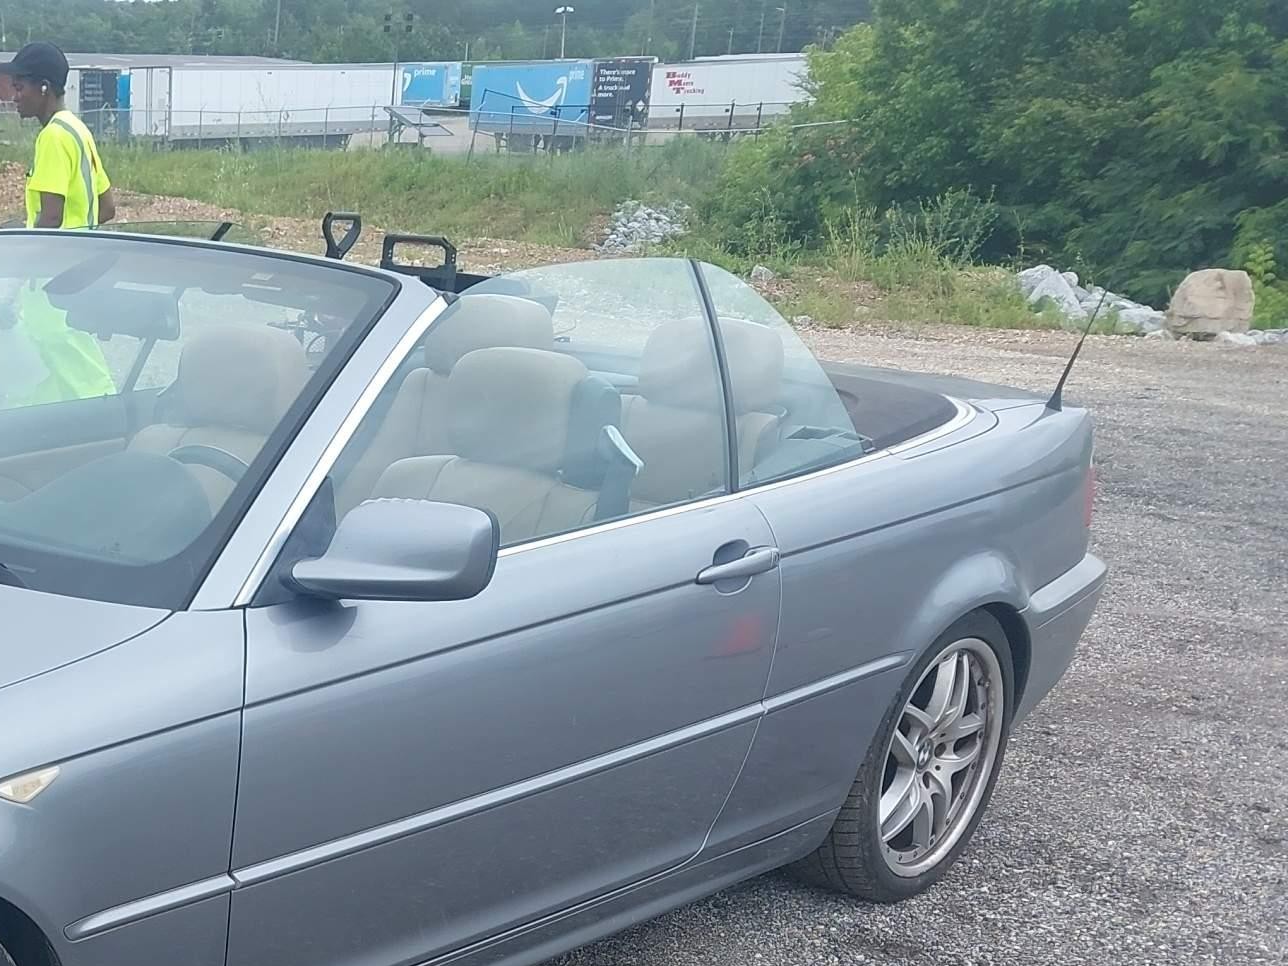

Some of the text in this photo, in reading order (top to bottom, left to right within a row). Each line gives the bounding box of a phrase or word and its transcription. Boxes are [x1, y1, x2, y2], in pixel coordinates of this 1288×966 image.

[414, 66, 437, 77] prime
[666, 71, 691, 79] Buddy
[672, 87, 705, 95] Trucking
